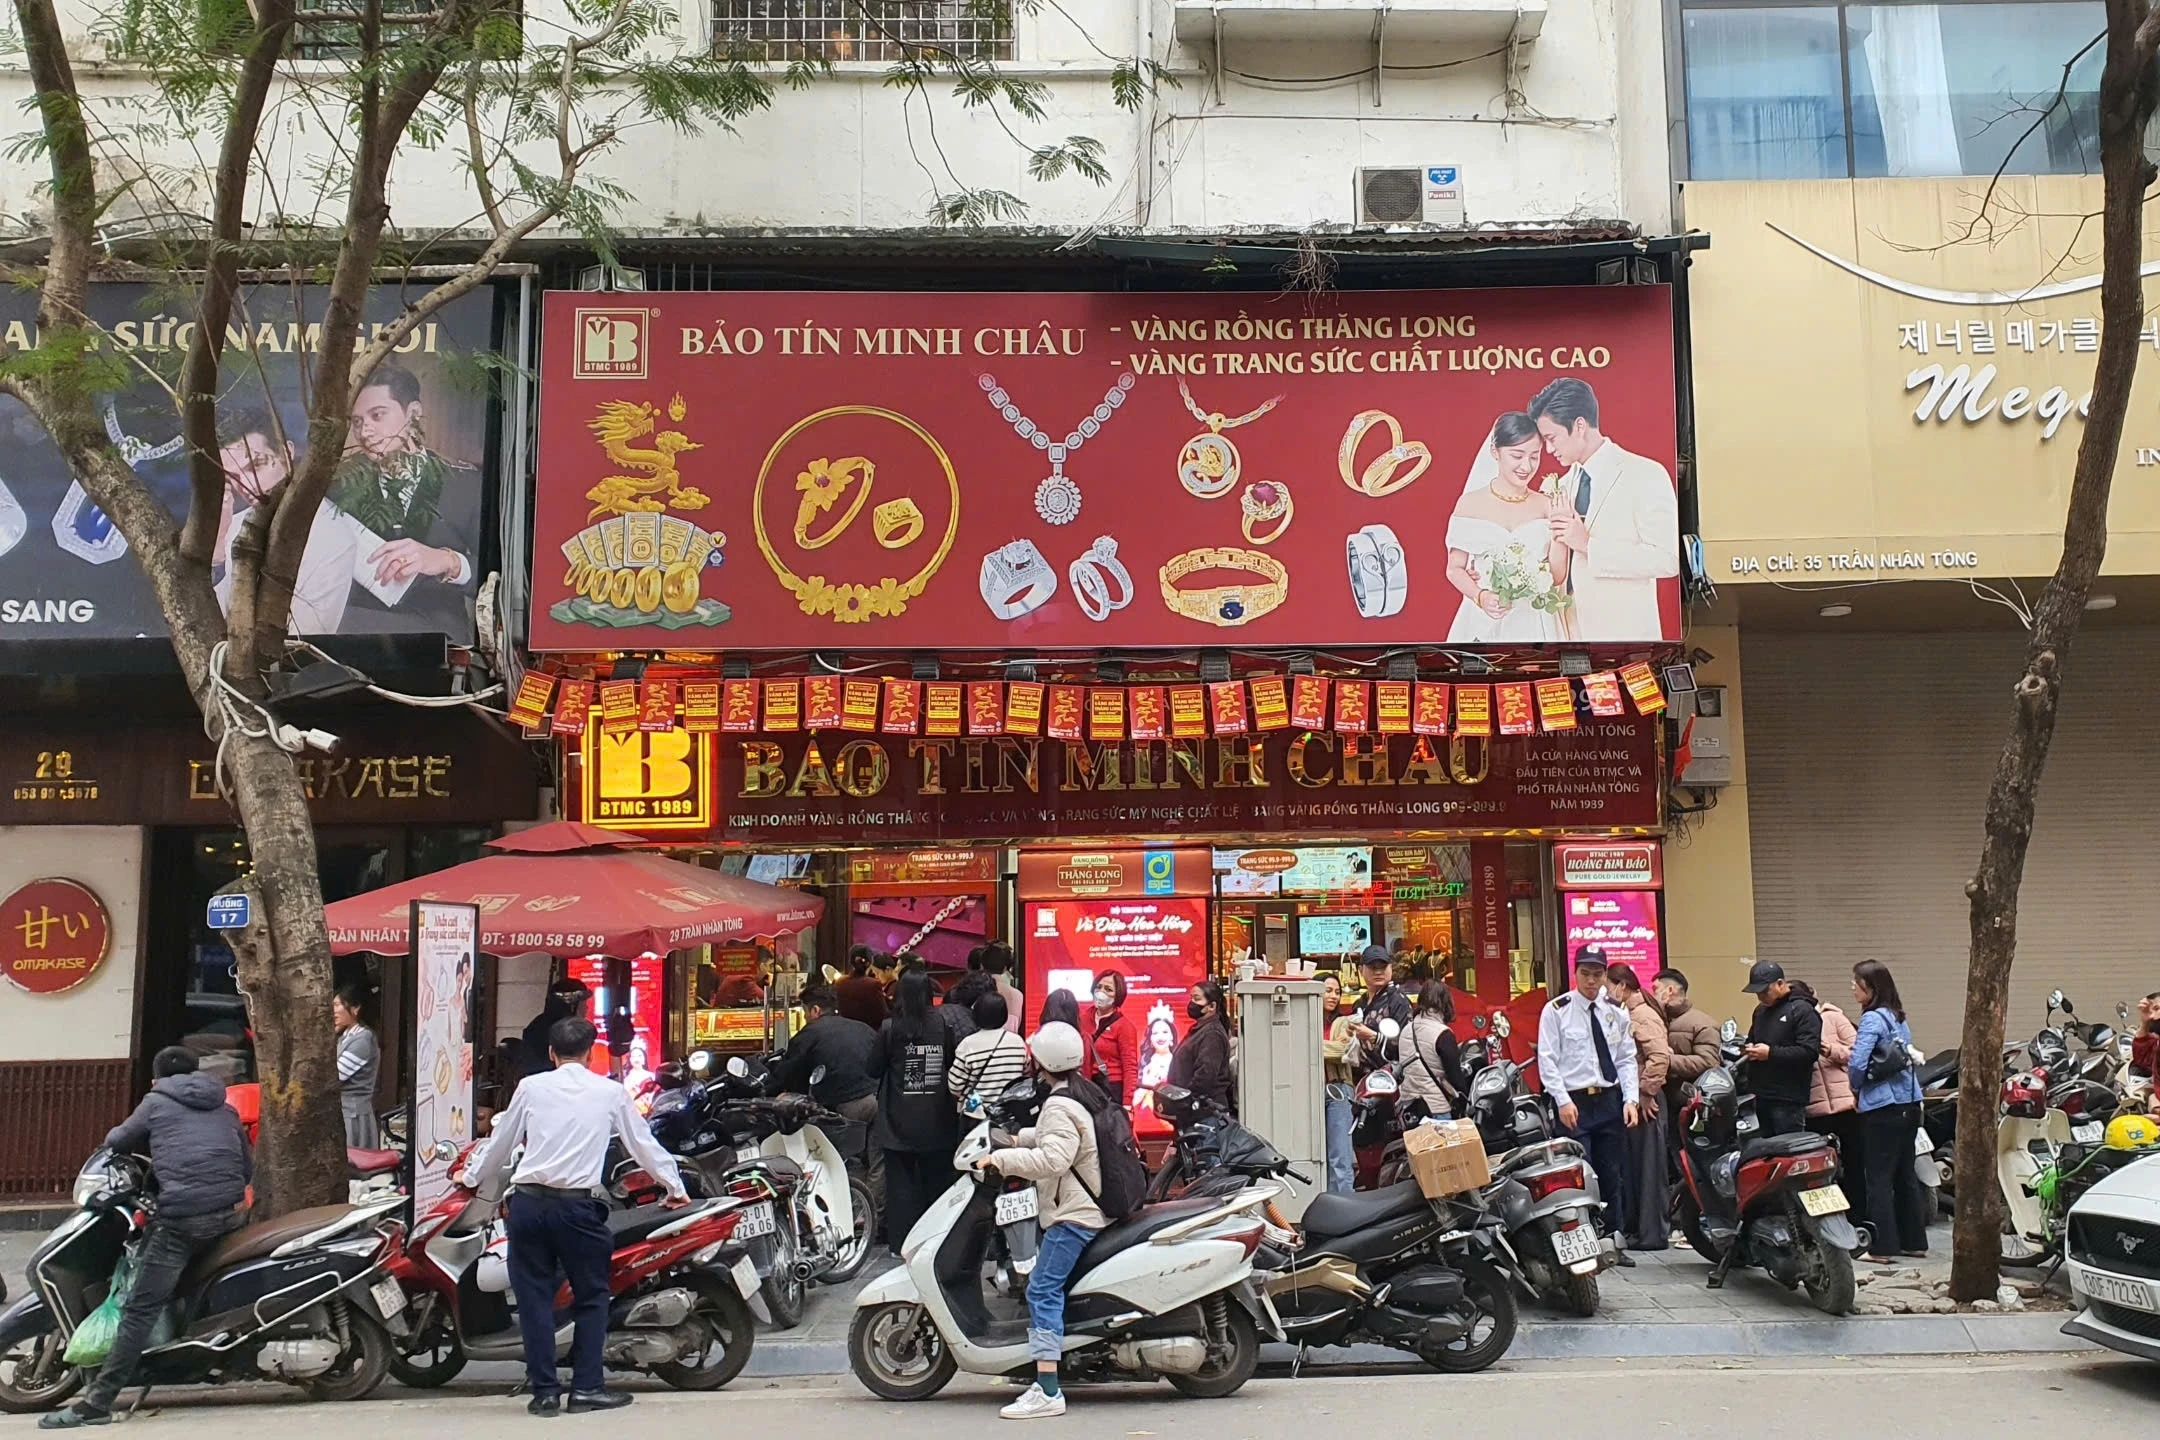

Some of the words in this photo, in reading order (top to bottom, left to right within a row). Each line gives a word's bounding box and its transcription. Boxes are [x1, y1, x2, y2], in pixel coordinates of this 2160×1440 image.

[1131, 314, 1206, 341] VÀNG
[1214, 309, 1294, 341] RỒNG
[1299, 313, 1393, 340] THĂNG
[1400, 315, 1475, 338] LONG
[679, 319, 764, 355] BẢO
[774, 320, 842, 355] TÍN
[854, 328, 962, 355] MINH
[973, 320, 1087, 355] CHÂU
[1129, 348, 1206, 375] VÀNG
[1212, 352, 1304, 374] TRANG
[1310, 346, 1364, 374] SỨC
[1370, 340, 1442, 372] CHẤT
[1448, 345, 1544, 376] LƯỢNG
[1550, 346, 1611, 369] CAO
[584, 362, 610, 372] BTMC
[614, 362, 637, 371] 1989
[1731, 556, 1760, 574] ĐỊA
[1804, 556, 1823, 570] 35
[1828, 548, 1875, 570] TRẦN
[1880, 550, 1926, 568] NHÂN
[1932, 549, 1978, 567] TÔNG
[1, 599, 95, 623] SANG
[1599, 722, 1636, 737] TÔNG
[1599, 748, 1629, 760] VÀNG
[36, 751, 73, 778] 29
[1060, 731, 1270, 793] MINH
[1593, 766, 1625, 777] BTMC
[1628, 764, 1642, 776] VÀ
[1608, 780, 1640, 792] TÔNG
[600, 801, 646, 815] BTMC
[651, 800, 692, 815] 1989
[1406, 801, 1440, 814] LONG
[1580, 799, 1605, 810] 1989
[729, 814, 758, 828] KINH
[1059, 869, 1092, 880] THĂNG
[1095, 870, 1120, 879] LONG
[1484, 865, 1496, 891] 1989
[221, 912, 238, 924] 17
[1485, 895, 1497, 936] BTMC
[328, 927, 357, 942] RẦN
[482, 932, 505, 946] ĐT:
[510, 933, 543, 947] 1800
[546, 933, 564, 947] 58
[566, 934, 585, 948] 58
[587, 935, 605, 948] 99
[670, 929, 680, 943] 29
[1560, 1241, 1598, 1262] 951.60
